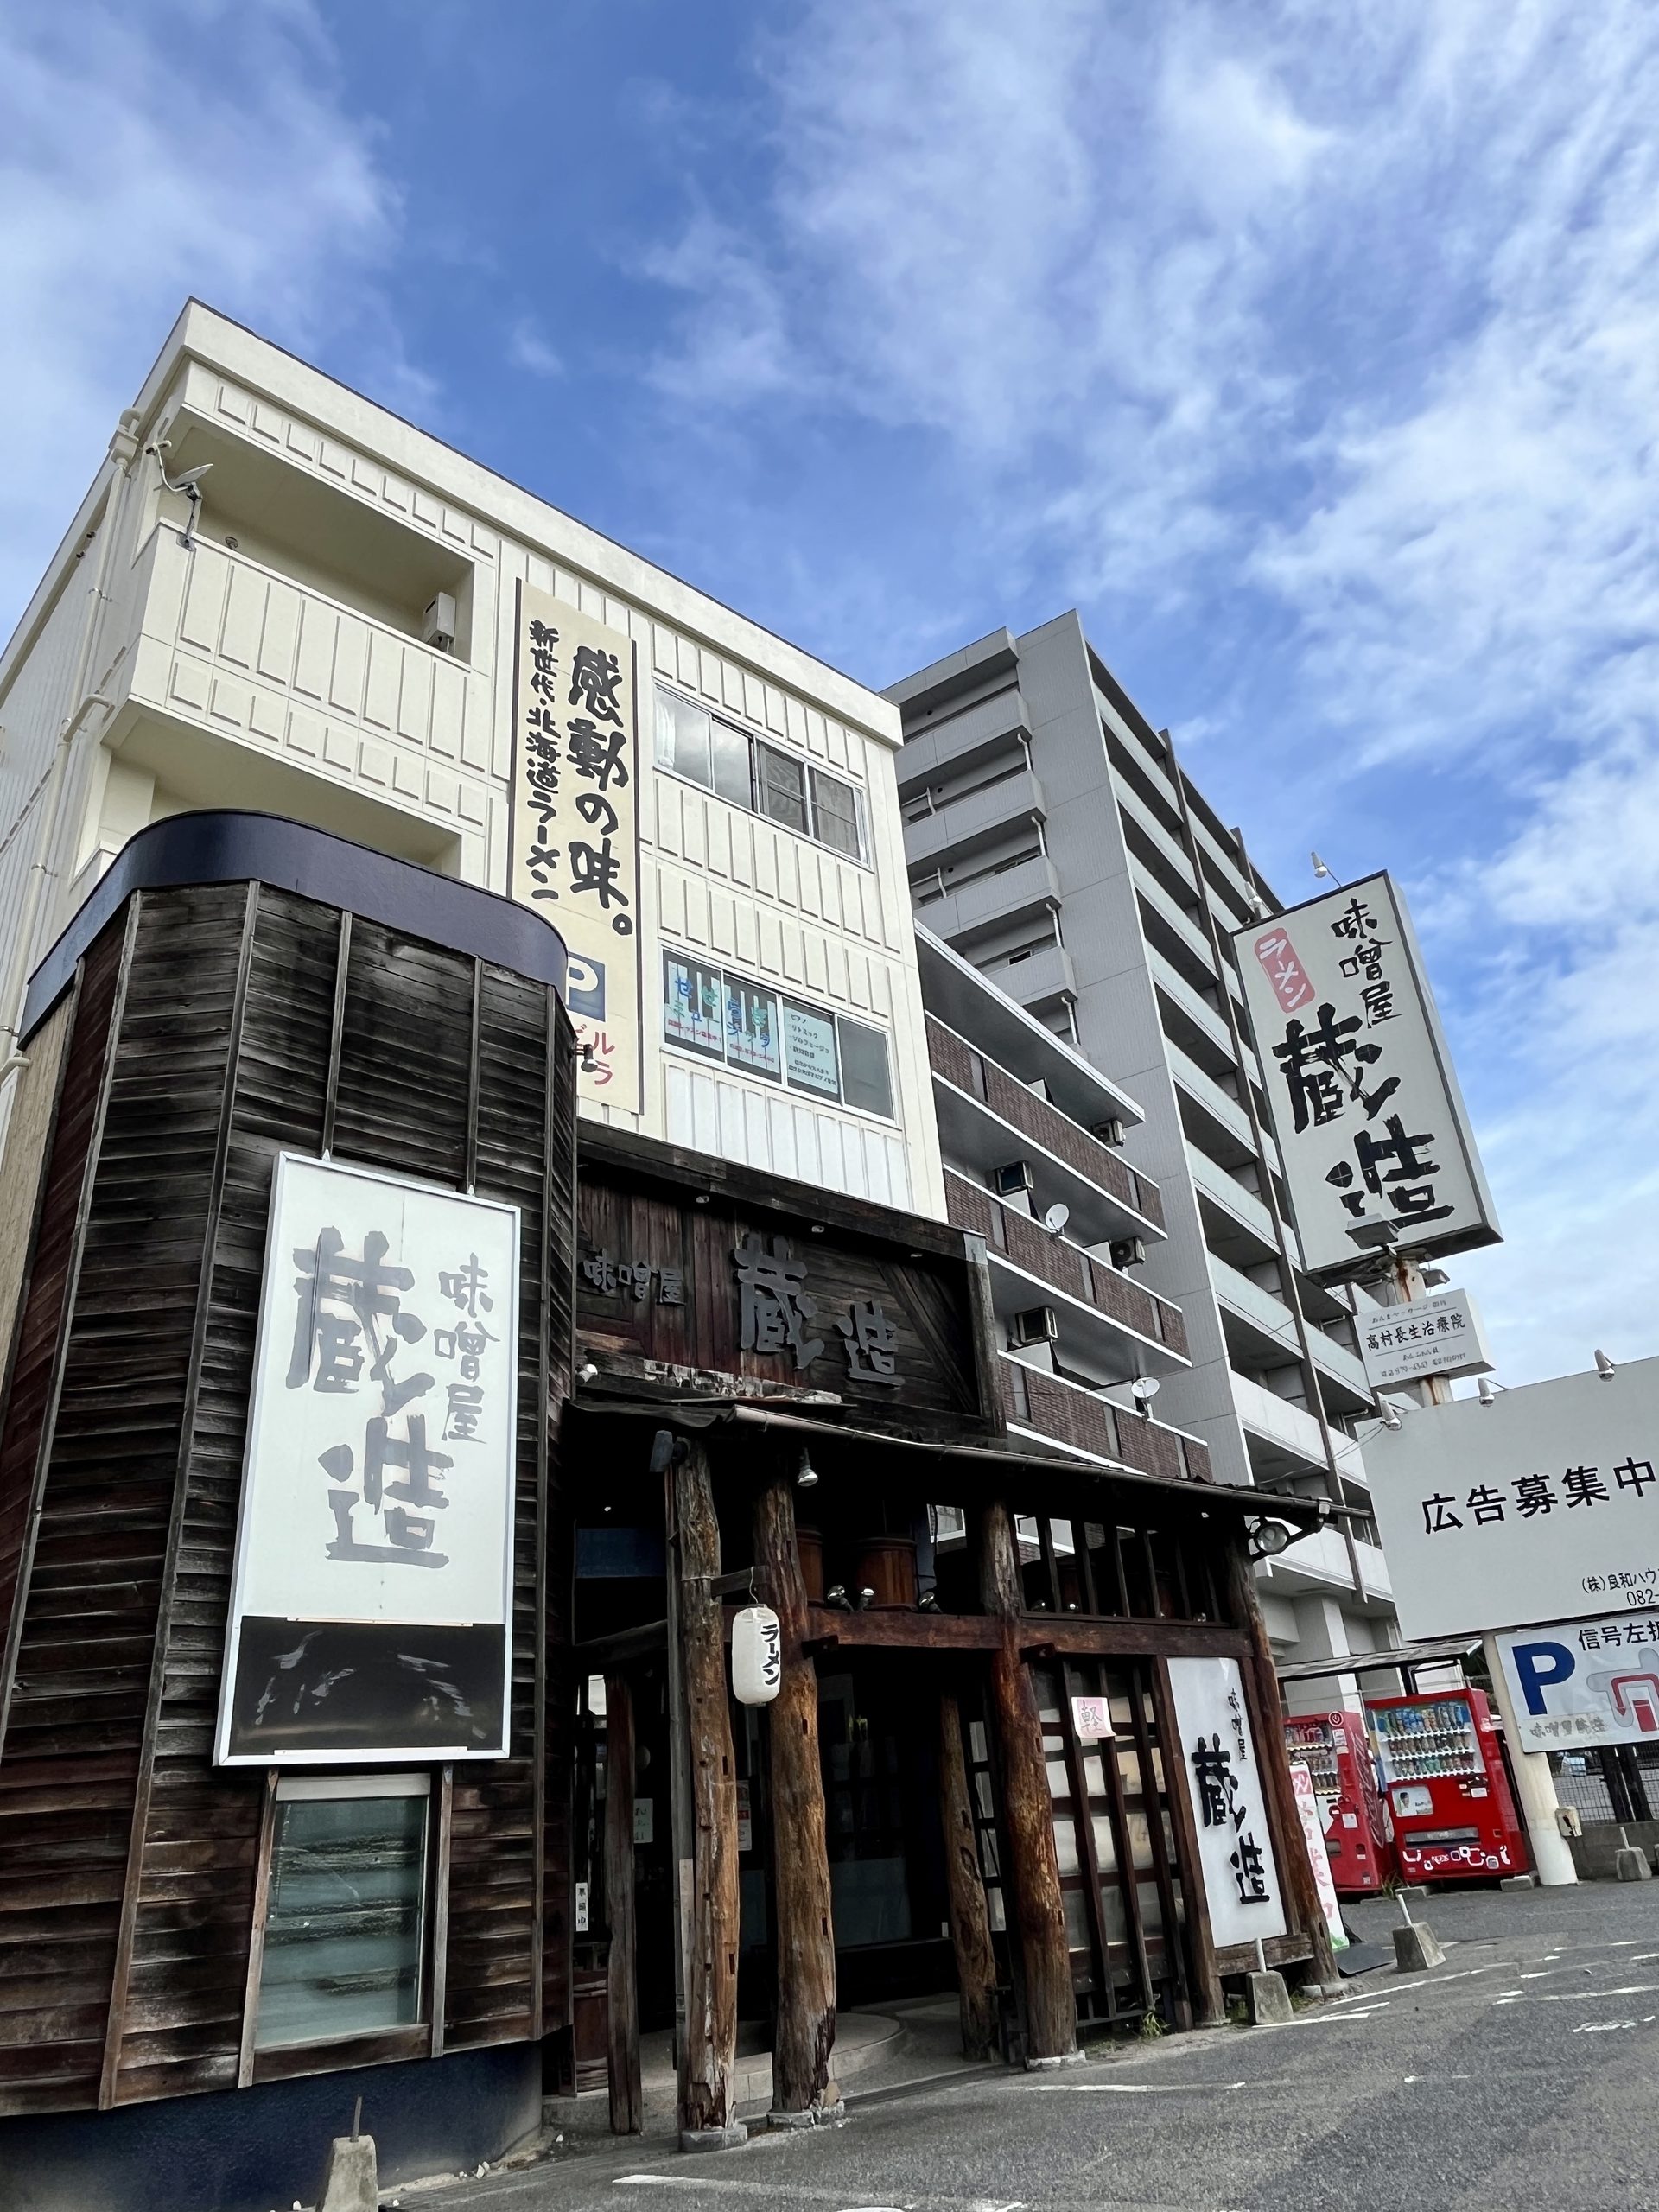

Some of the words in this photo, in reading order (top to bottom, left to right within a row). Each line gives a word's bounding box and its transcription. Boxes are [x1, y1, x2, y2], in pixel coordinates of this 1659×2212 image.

[567, 645, 632, 935] 感動の味。
[566, 956, 599, 1005] P
[1258, 938, 1306, 1008] ラーメン
[1332, 897, 1402, 1028] 味噌屋
[1272, 1002, 1455, 1229] 蔵造
[583, 1249, 686, 1306] 味噌屋
[730, 1232, 906, 1388] 蔵造
[434, 1253, 502, 1444] 味噌屋
[1366, 1313, 1466, 1351] 高村長生治療院
[286, 1224, 454, 1569] 蔵造
[1421, 1457, 1656, 1535] 広告募集中
[1582, 1567, 1659, 1594] (株)良和ハウ
[760, 1624, 779, 1685] ラーメン
[1512, 1642, 1575, 1716] P
[1191, 1733, 1270, 1904] 蔵造
